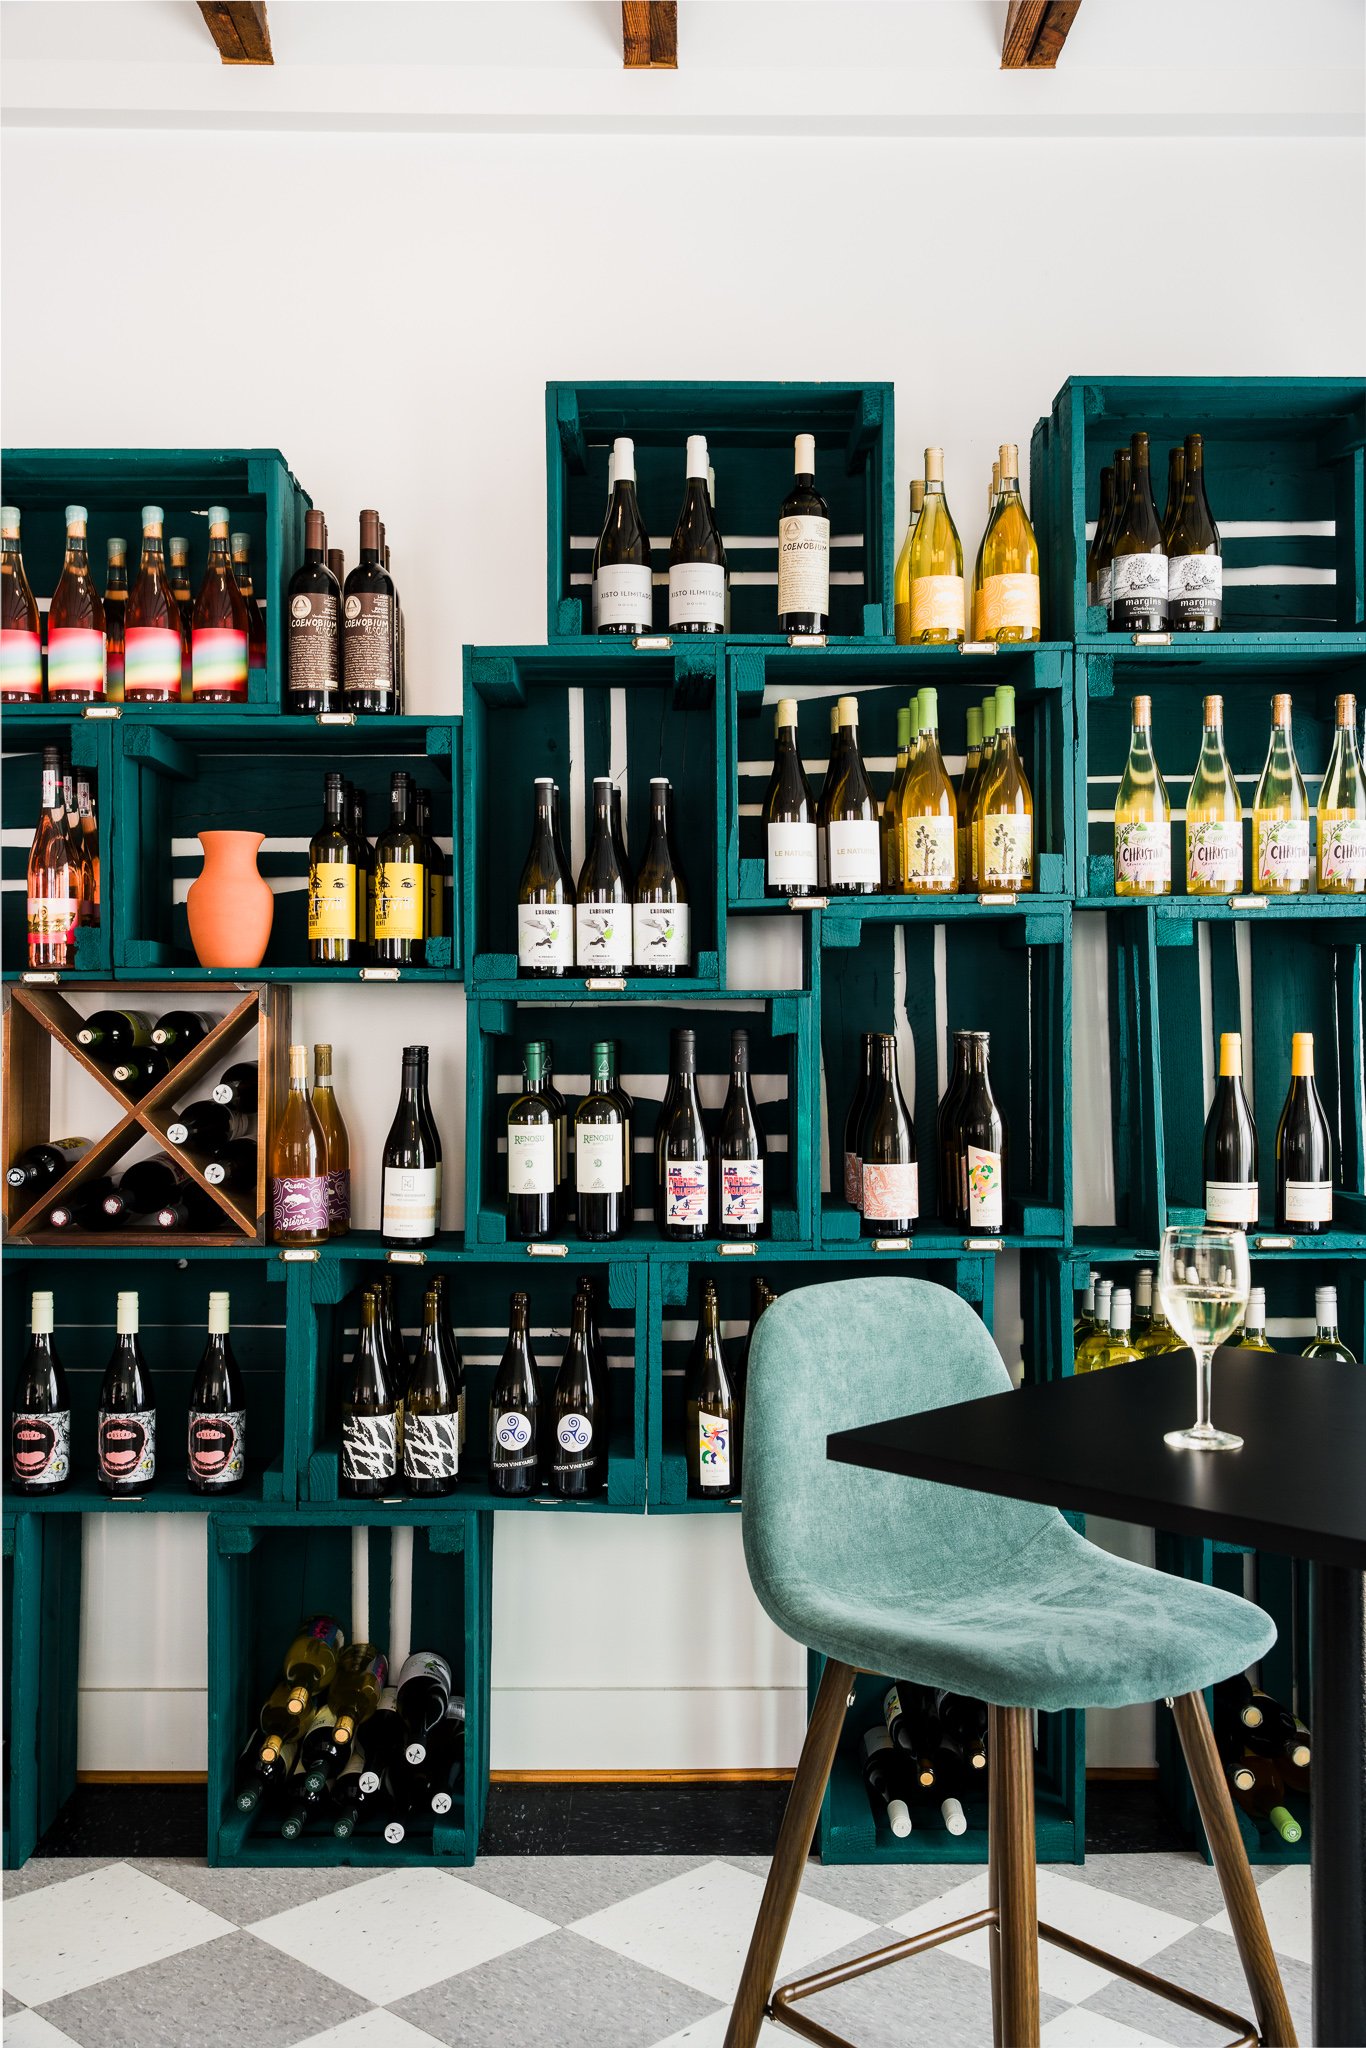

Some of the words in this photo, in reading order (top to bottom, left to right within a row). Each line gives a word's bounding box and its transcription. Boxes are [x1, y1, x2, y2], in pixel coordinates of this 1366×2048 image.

[783, 542, 828, 552] COENOBIUM
[689, 589, 723, 599] ILIMITADO
[1125, 598, 1162, 609] margins
[1180, 599, 1217, 609] margins
[291, 618, 337, 629] COENOBIUM
[344, 618, 389, 629] COENOBIUM
[514, 1135, 545, 1145] RENOSU
[583, 1134, 614, 1144] RENOSU
[283, 1181, 306, 1192] Queen
[283, 1217, 310, 1228] Sierra
[509, 1459, 534, 1467] VINEYARD
[569, 1460, 594, 1470] VINEYARD
